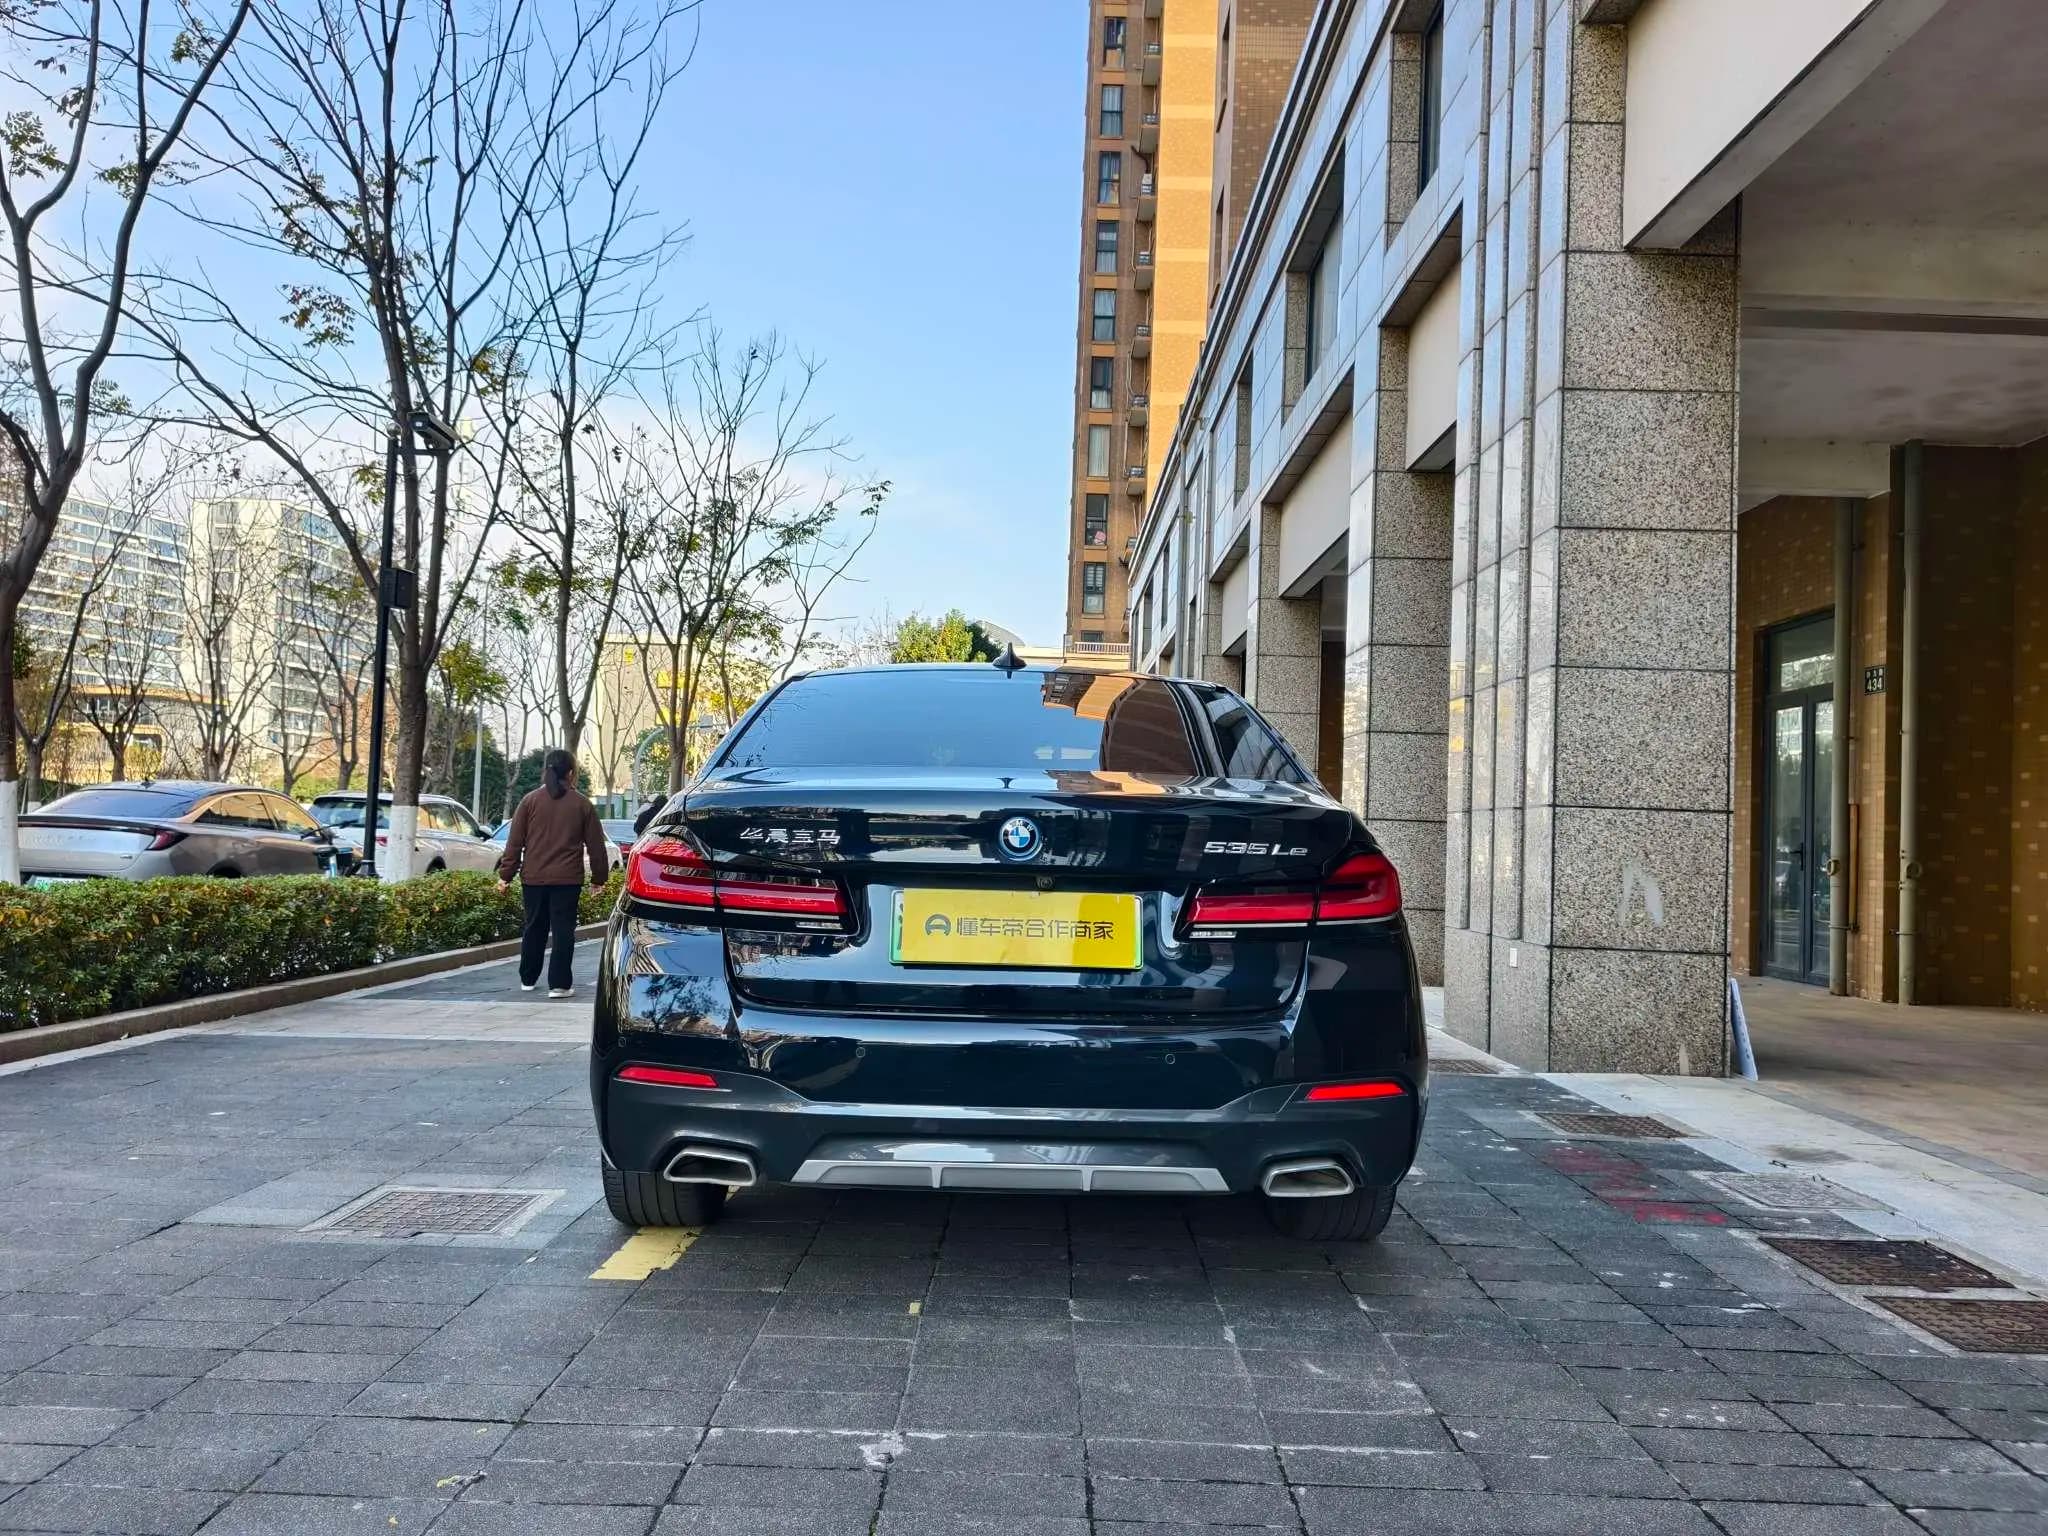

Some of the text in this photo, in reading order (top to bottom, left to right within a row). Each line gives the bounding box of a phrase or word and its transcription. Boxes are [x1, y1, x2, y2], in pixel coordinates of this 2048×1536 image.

[1866, 677, 1882, 692] 434
[739, 828, 841, 845] 华晨宝马
[956, 917, 1114, 940] 懂车帝合作商家
